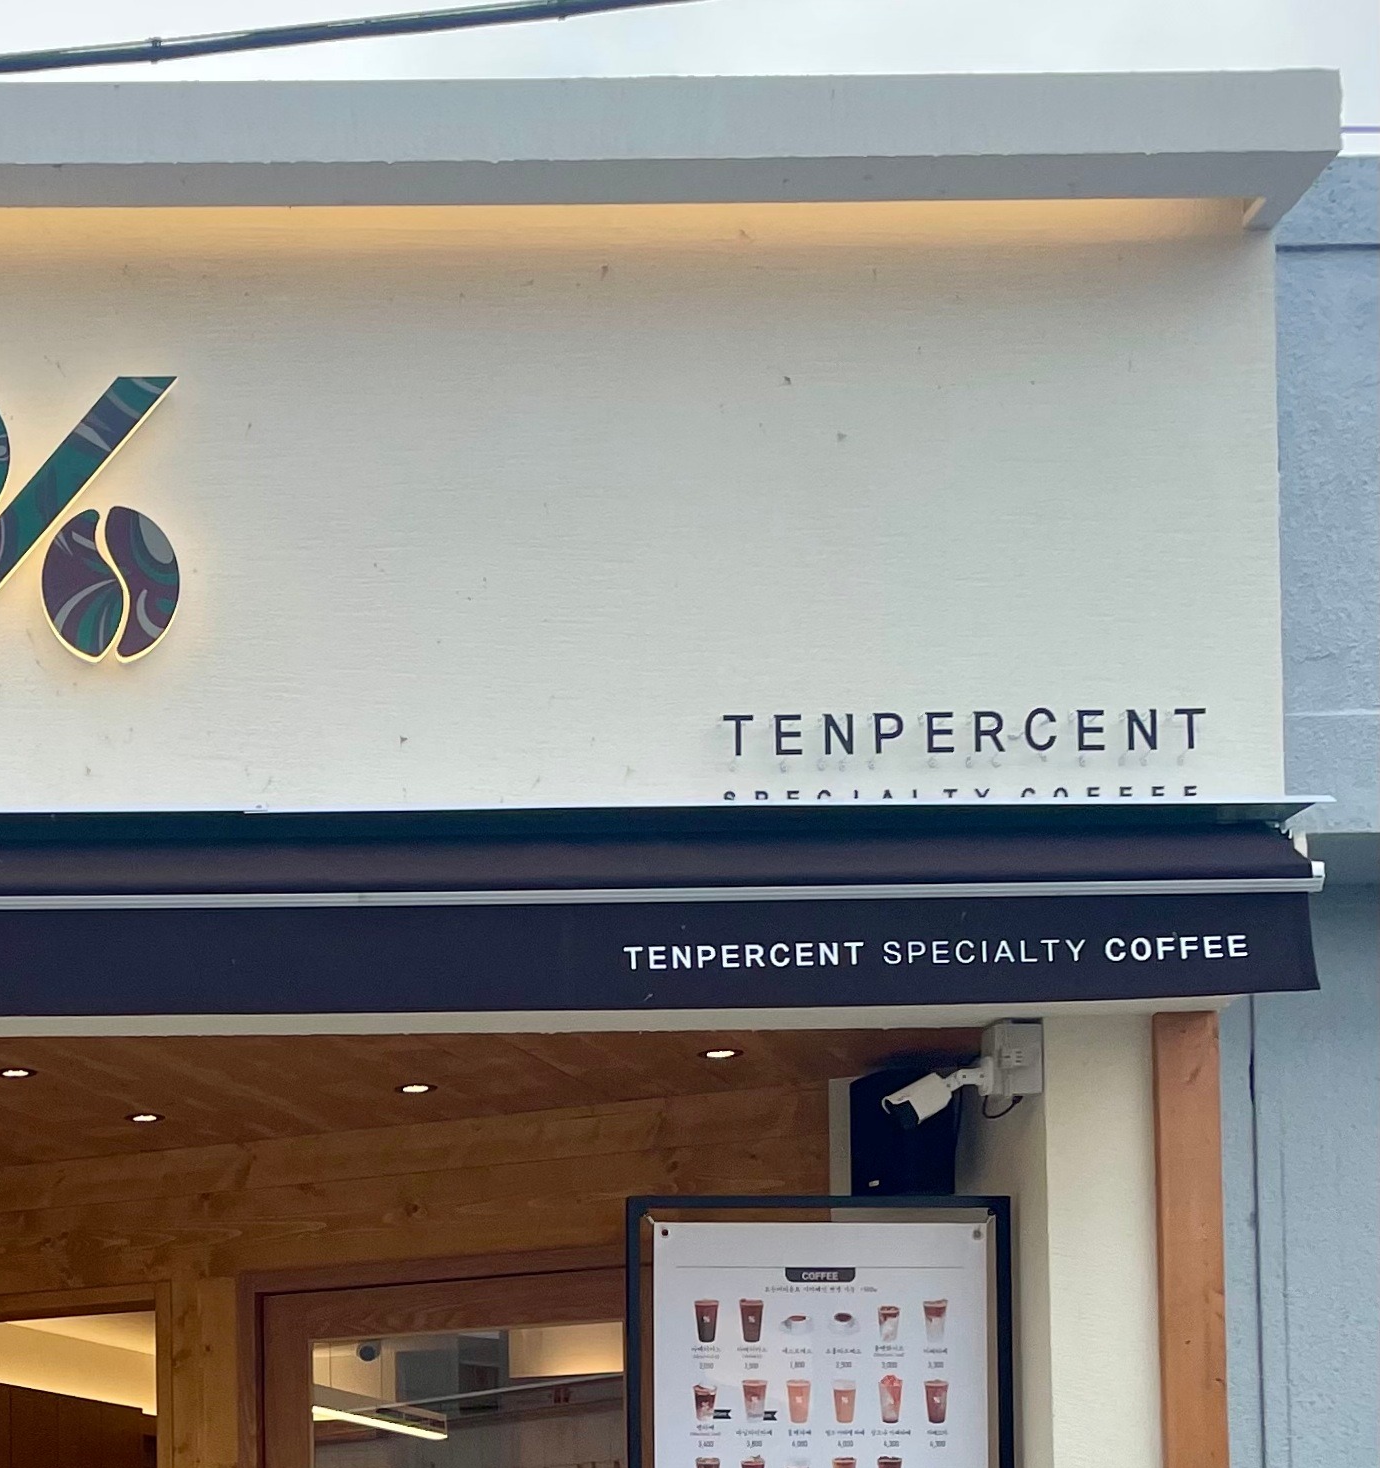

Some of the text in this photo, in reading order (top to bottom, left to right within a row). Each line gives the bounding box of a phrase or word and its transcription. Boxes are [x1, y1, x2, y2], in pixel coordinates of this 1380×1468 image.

[723, 707, 1207, 756] TENPERCENT
[623, 935, 1250, 971] TENPERCENT SPECIALTY COFFEE
[801, 1271, 839, 1281] COFFEE
